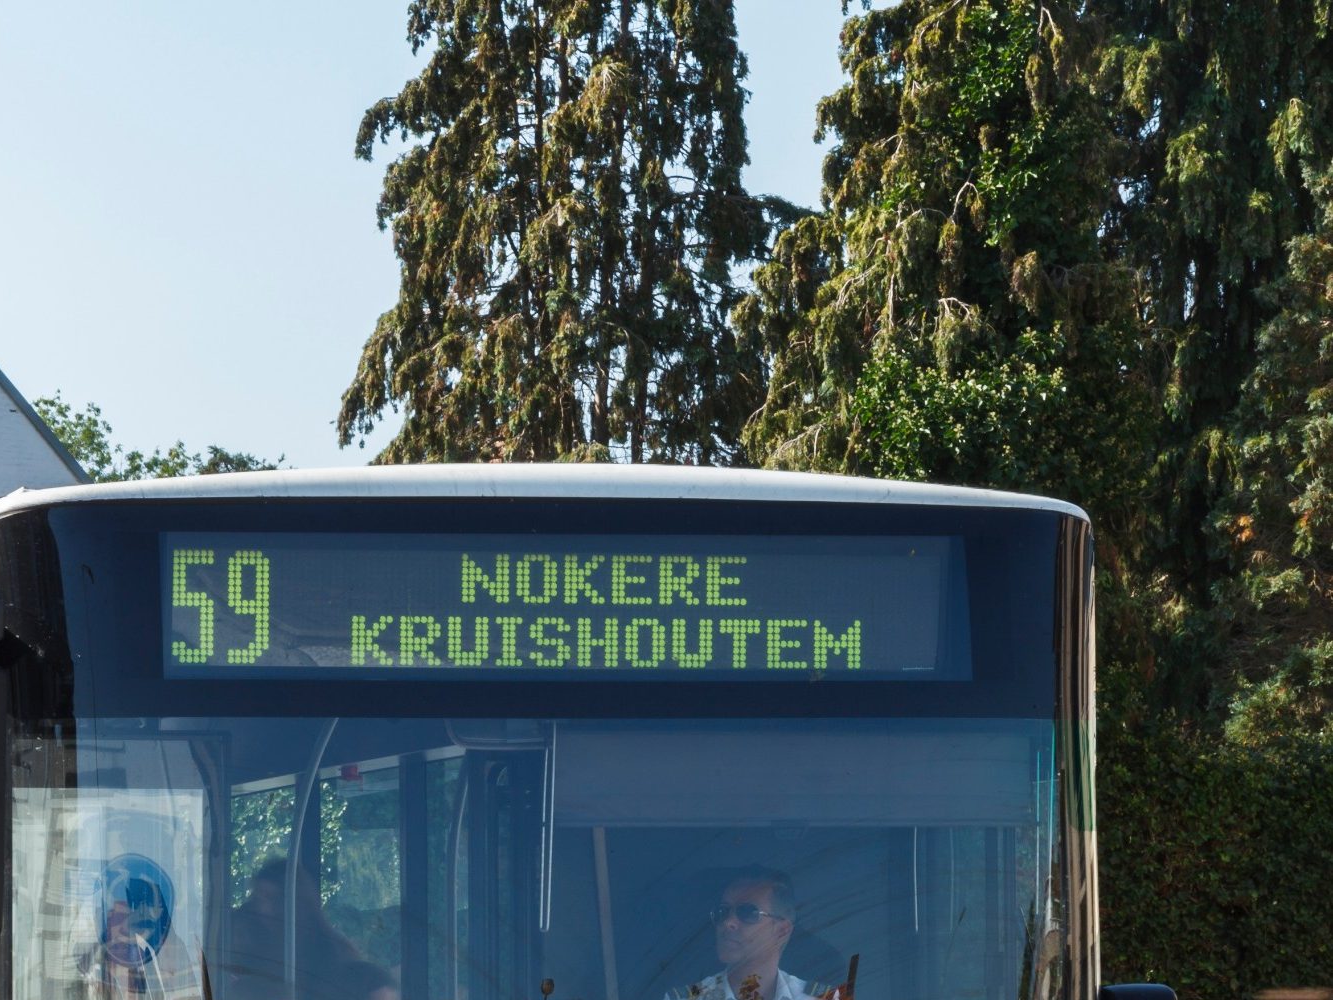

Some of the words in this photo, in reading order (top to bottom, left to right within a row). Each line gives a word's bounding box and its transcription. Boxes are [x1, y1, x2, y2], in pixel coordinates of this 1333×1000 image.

[173, 550, 269, 663] 59
[462, 553, 747, 606] NOKERE
[352, 615, 861, 669] KRUISHOUTEM
